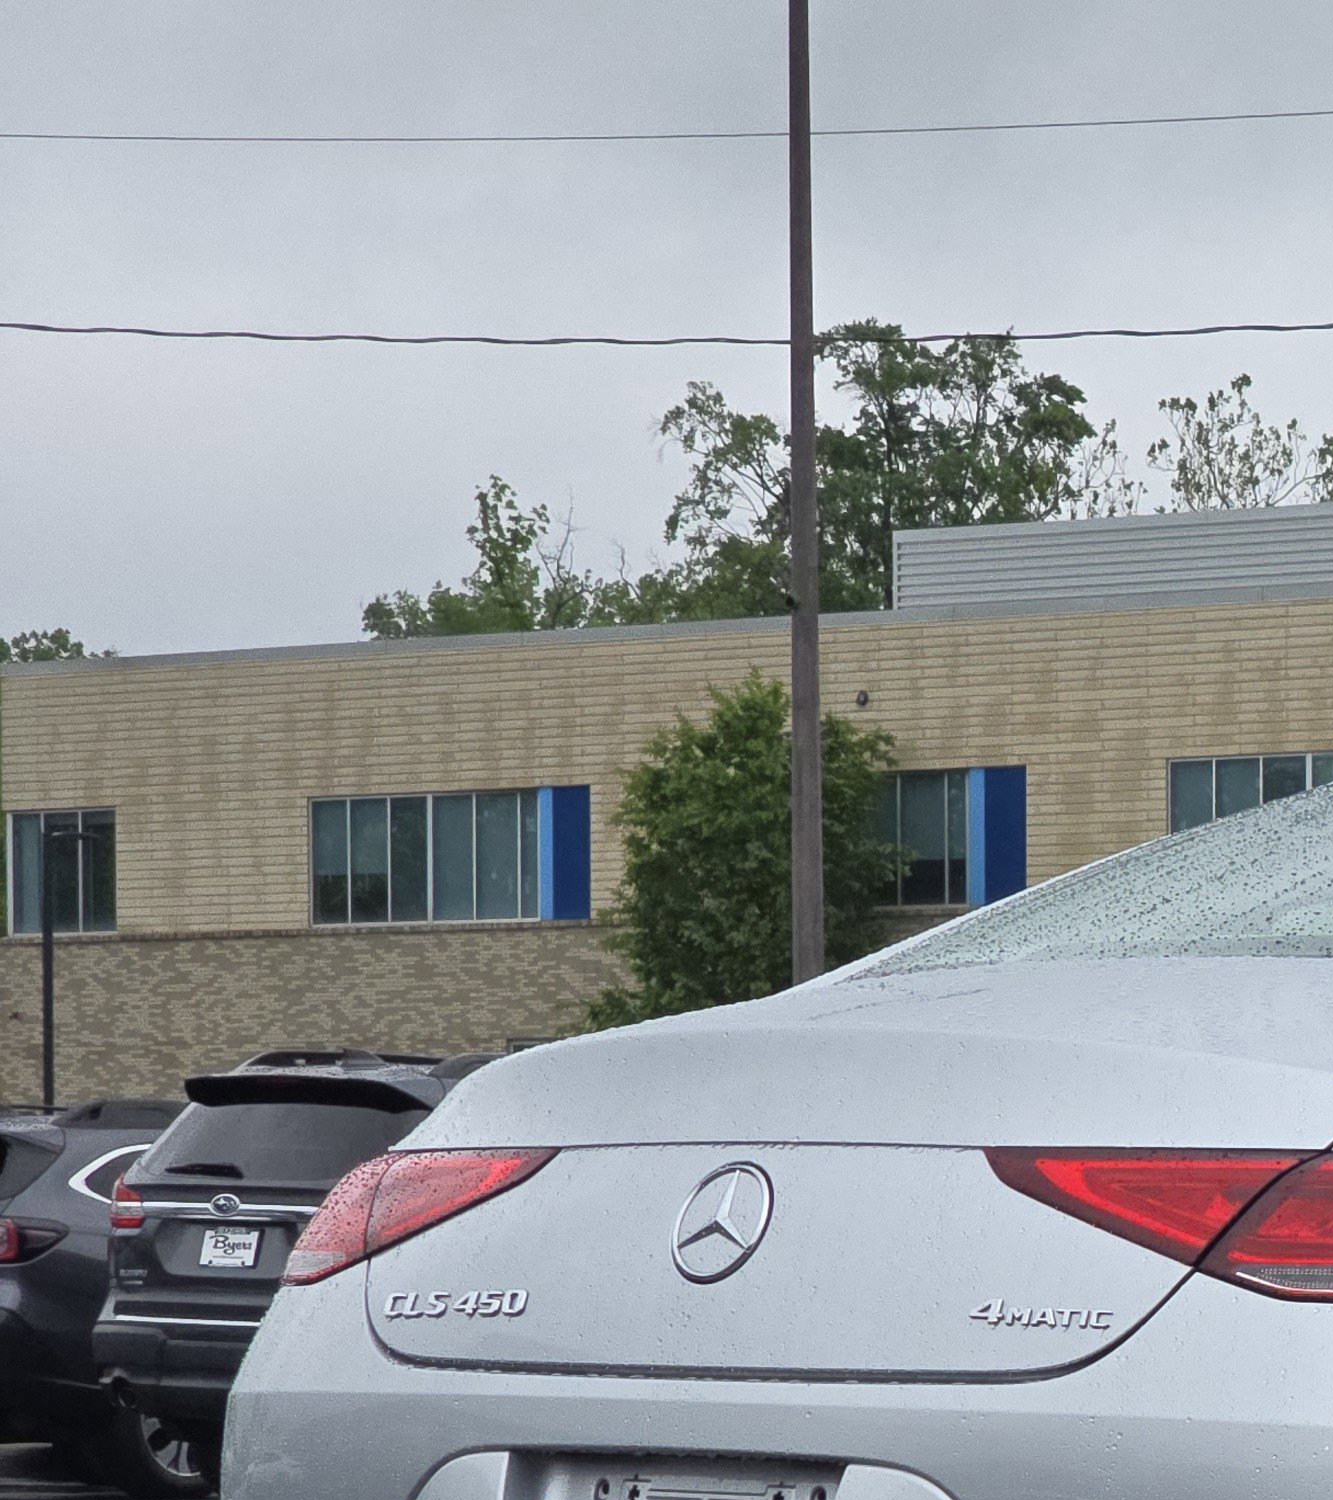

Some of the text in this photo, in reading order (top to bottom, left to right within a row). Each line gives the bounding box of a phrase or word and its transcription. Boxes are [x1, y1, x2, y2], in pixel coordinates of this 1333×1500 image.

[384, 1289, 529, 1318] CLS 450
[969, 1299, 1114, 1329] 4MATIC
